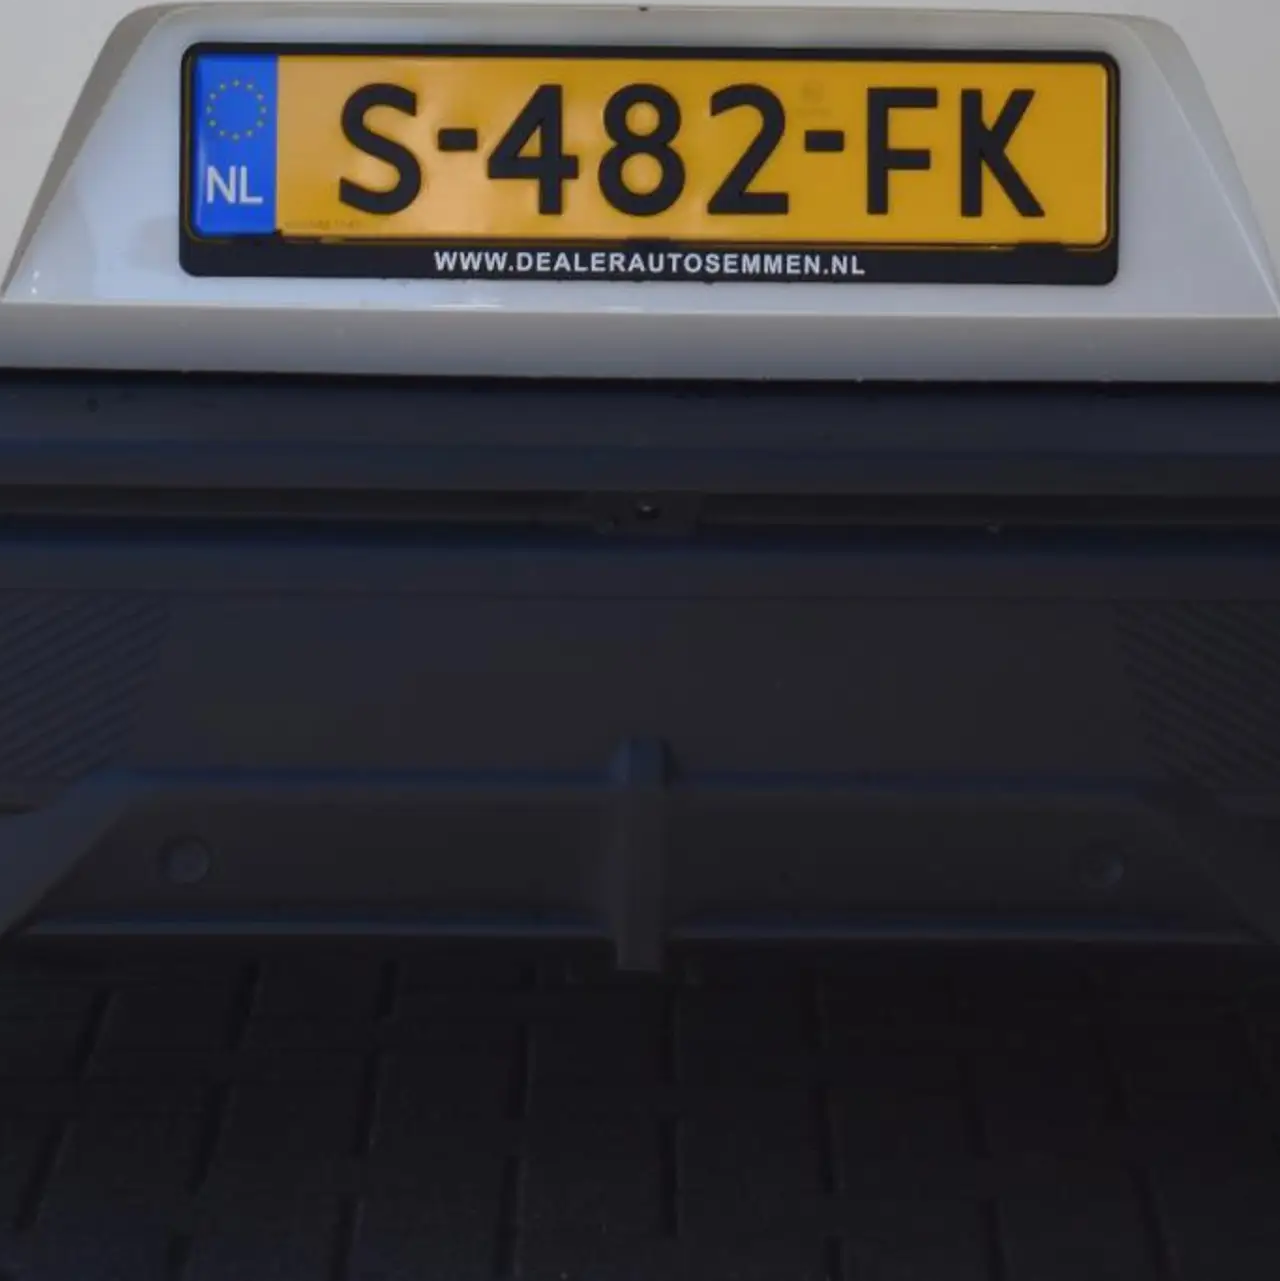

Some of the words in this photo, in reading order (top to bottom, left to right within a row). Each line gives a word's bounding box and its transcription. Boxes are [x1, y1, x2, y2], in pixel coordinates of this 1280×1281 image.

[337, 82, 1046, 218] S-482-FK
[206, 165, 264, 205] NL
[434, 250, 866, 276] WWW.DEALERAUTOSEMMEN.NL
